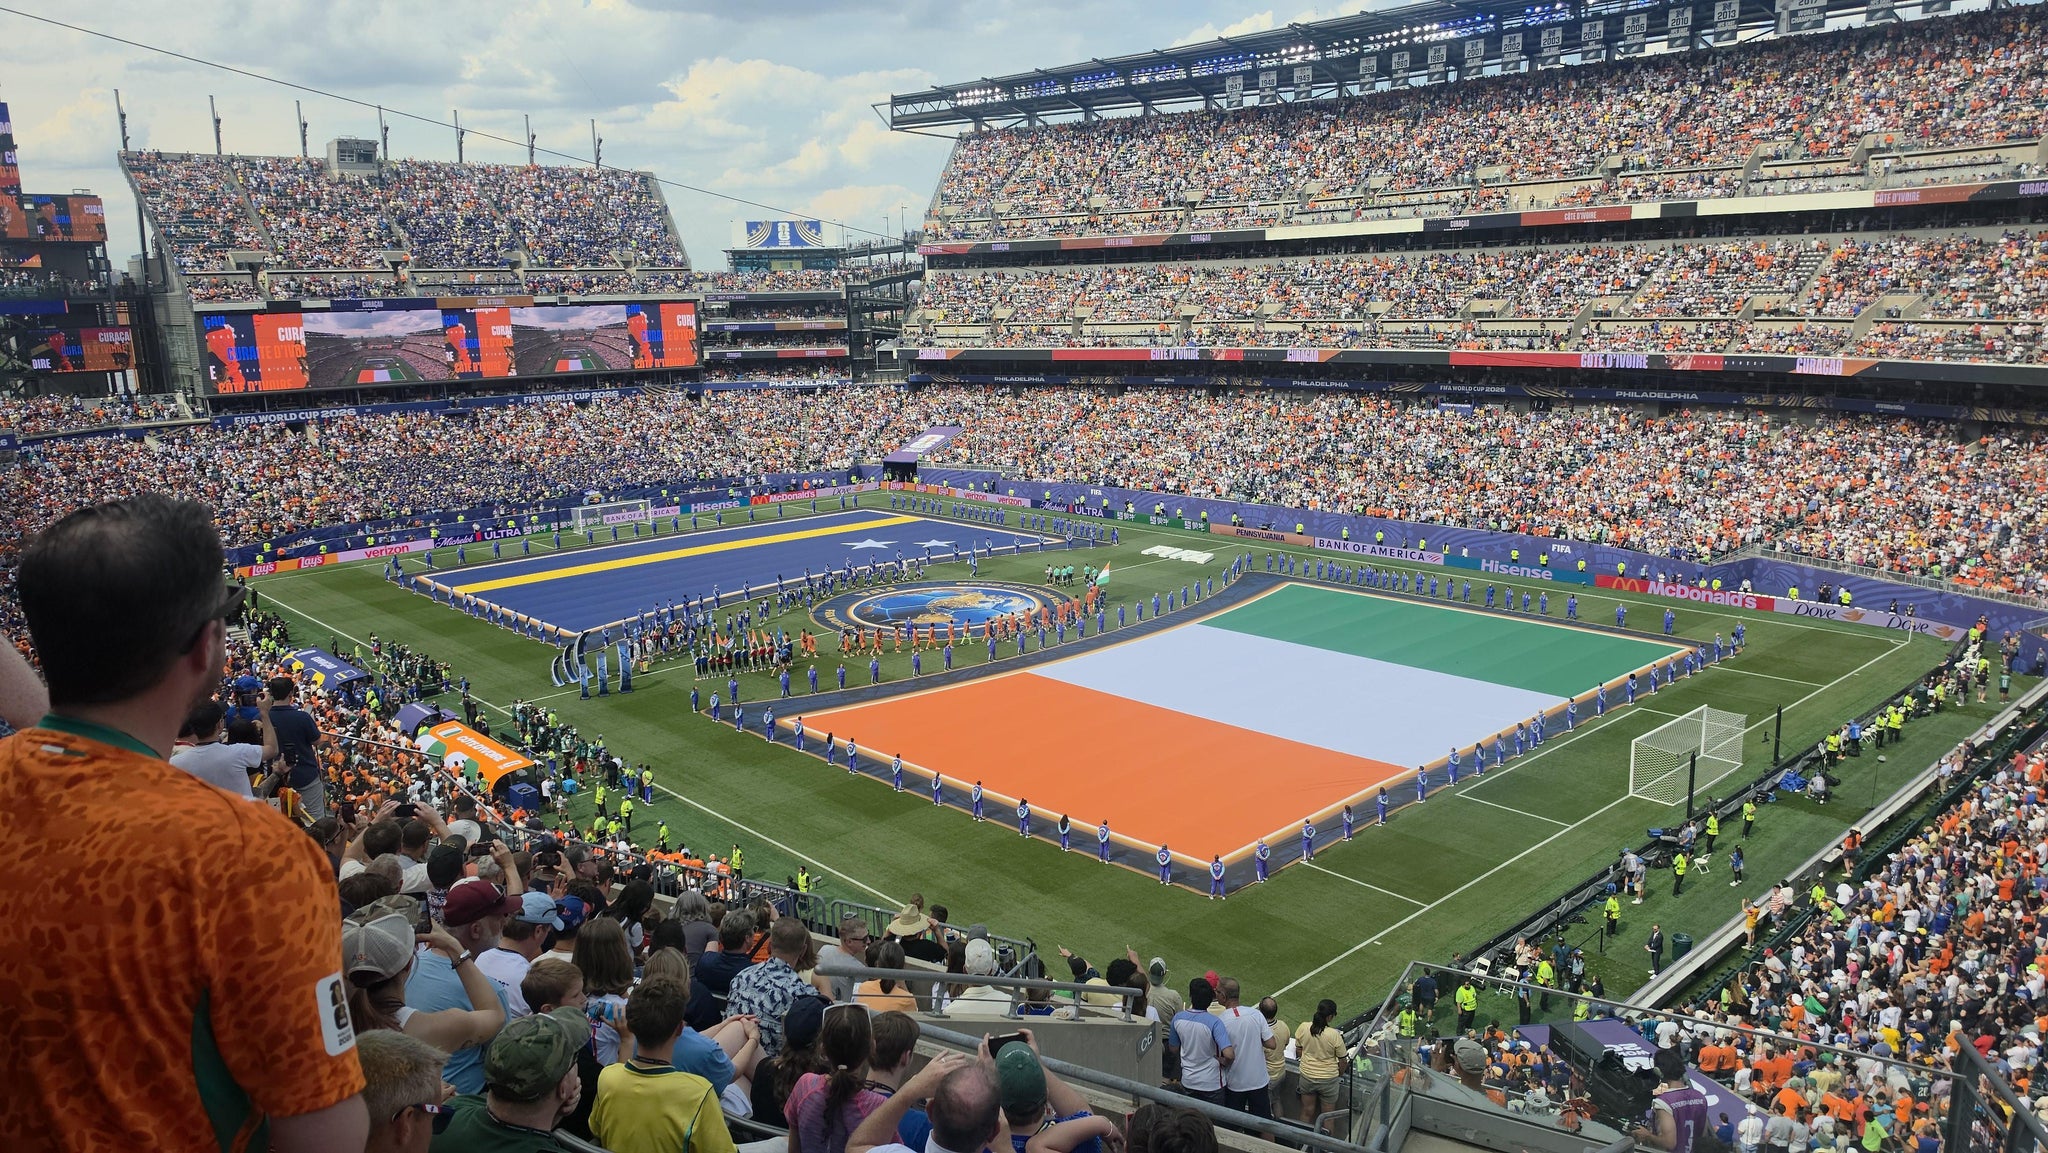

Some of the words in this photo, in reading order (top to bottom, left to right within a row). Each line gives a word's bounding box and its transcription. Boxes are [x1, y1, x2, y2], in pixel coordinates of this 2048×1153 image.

[1717, 10, 1736, 20] 2013
[1798, 8, 1817, 17] WORLD
[1671, 16, 1688, 26] 2010
[1791, 13, 1824, 24] CHAMPIONS
[1543, 37, 1560, 45] 2003
[1583, 31, 1601, 40] 2004
[1504, 42, 1521, 50] 2002
[1467, 48, 1482, 57] 2001
[1228, 83, 1242, 91] 1947
[1875, 193, 1891, 204] CÔTE
[1892, 191, 1920, 203] D'IVOIRE
[1564, 212, 1576, 221] CÔTE
[1577, 211, 1597, 219] D'IVOIRE
[1450, 219, 1470, 229] CURAÇAO
[1605, 354, 1648, 368] D'IVOIRE
[769, 379, 839, 388] PHILADELPHIA
[1292, 380, 1349, 388] PHILADELPHIA
[523, 395, 541, 404] FIFA
[542, 393, 573, 403] WORLD
[574, 392, 590, 401] CUP
[590, 390, 619, 399] 2026
[1615, 390, 1699, 400] PHILADELPHIA
[234, 414, 258, 425] FIFA
[258, 412, 297, 424] WORLD
[298, 410, 319, 419] CUP
[320, 408, 357, 418] 2026
[769, 490, 815, 503] McDonald's
[832, 486, 852, 496] Dove
[964, 491, 987, 501] verizon
[1090, 488, 1102, 496] FIFA
[691, 500, 740, 513] Hisense
[997, 496, 1022, 506] verizon
[1040, 500, 1068, 513] Michelob
[1075, 505, 1104, 517] ULTRA
[605, 514, 626, 523] BANK
[628, 512, 637, 520] OF
[434, 534, 474, 549] Michelob
[484, 528, 521, 540] ULTRA
[1236, 528, 1285, 542] PENNSYLVANIA
[365, 544, 410, 558] verizon
[1319, 539, 1349, 551] BANK
[1353, 543, 1368, 553] OF
[1370, 546, 1425, 561] AMERICA
[1551, 543, 1571, 554] FIFA
[300, 555, 323, 568] Lay's
[251, 563, 275, 577] Lay's
[1480, 558, 1553, 580] Hisense
[1647, 581, 1757, 609] McDonald's
[1794, 602, 1836, 620] Dove
[1886, 614, 1929, 634] Dove
